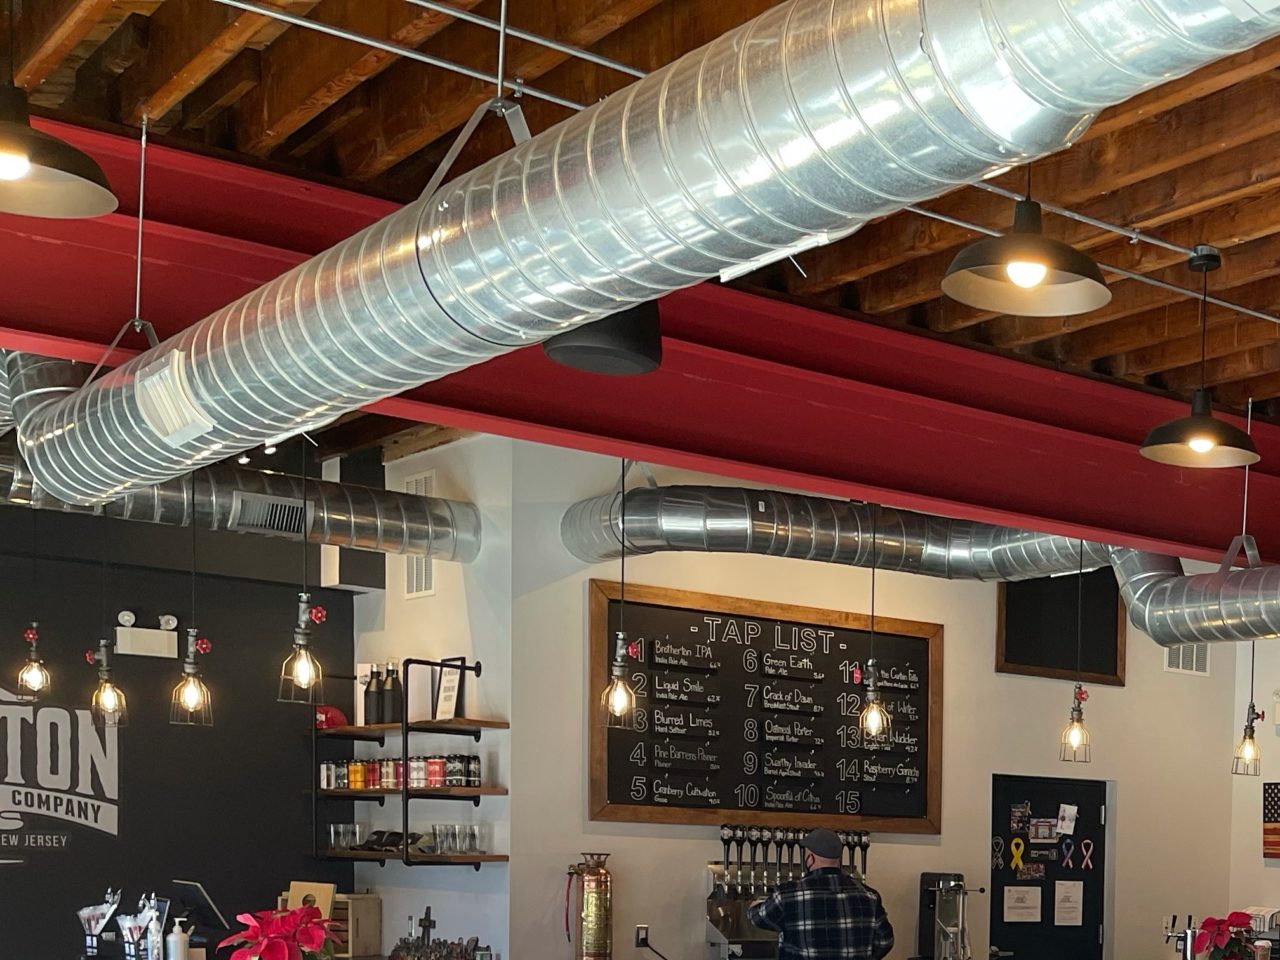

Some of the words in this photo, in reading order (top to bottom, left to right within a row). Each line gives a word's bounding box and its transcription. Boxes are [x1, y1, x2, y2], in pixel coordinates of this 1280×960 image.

[704, 616, 761, 645] TAP
[774, 625, 835, 654] LIST
[655, 640, 692, 657] Brotherton
[695, 644, 713, 659] IPA
[742, 648, 758, 673] 6
[763, 653, 787, 667] Green
[789, 655, 813, 670] Earth
[839, 660, 862, 684] 11
[632, 672, 647, 698] 2
[655, 676, 679, 692] Liquid
[683, 678, 704, 693] Smile
[744, 684, 760, 708] 7
[763, 685, 783, 701] Crack
[784, 692, 792, 702] of
[794, 689, 813, 704] Dawn
[836, 692, 860, 717] 12
[633, 707, 648, 733] 3
[654, 709, 684, 725] Blurred
[689, 712, 713, 728] Limes
[743, 718, 758, 743] 8
[793, 721, 813, 737] Porter
[836, 724, 860, 748] 13
[0, 704, 118, 800] TON
[629, 742, 647, 767] 4
[654, 744, 669, 759] Pine
[669, 745, 697, 760] Barrens
[743, 751, 758, 775] 9
[836, 758, 860, 782] 14
[864, 760, 896, 778] Raspberry
[630, 776, 646, 801] 5
[653, 779, 684, 798] Cranberry
[685, 782, 717, 798] Cultivation
[734, 783, 760, 808] 10
[11, 789, 101, 824] COMPANY
[835, 790, 860, 814] 15
[24, 834, 67, 847] JERSEY
